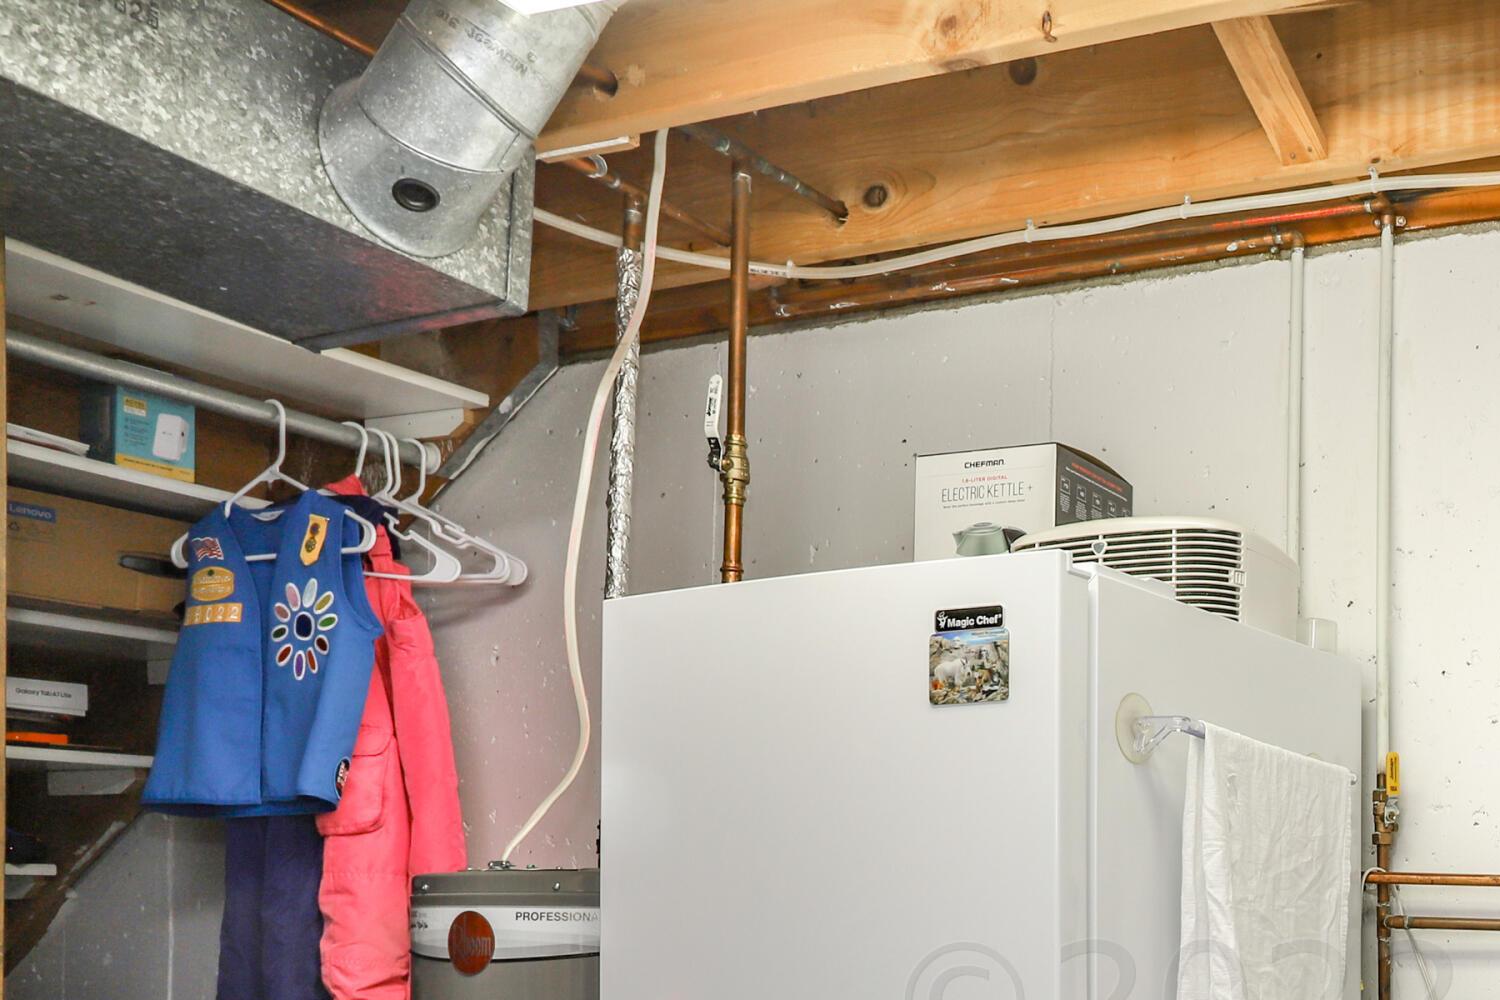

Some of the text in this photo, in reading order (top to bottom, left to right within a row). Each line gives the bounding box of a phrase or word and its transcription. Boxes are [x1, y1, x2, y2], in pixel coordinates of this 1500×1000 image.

[964, 458, 1005, 469] CHEFMAN
[941, 484, 985, 503] ELECTRIC
[987, 481, 1025, 499] KETTLE
[9, 503, 52, 519] Lenovo
[947, 616, 975, 629] Magic
[15, 687, 40, 697] Galaxy
